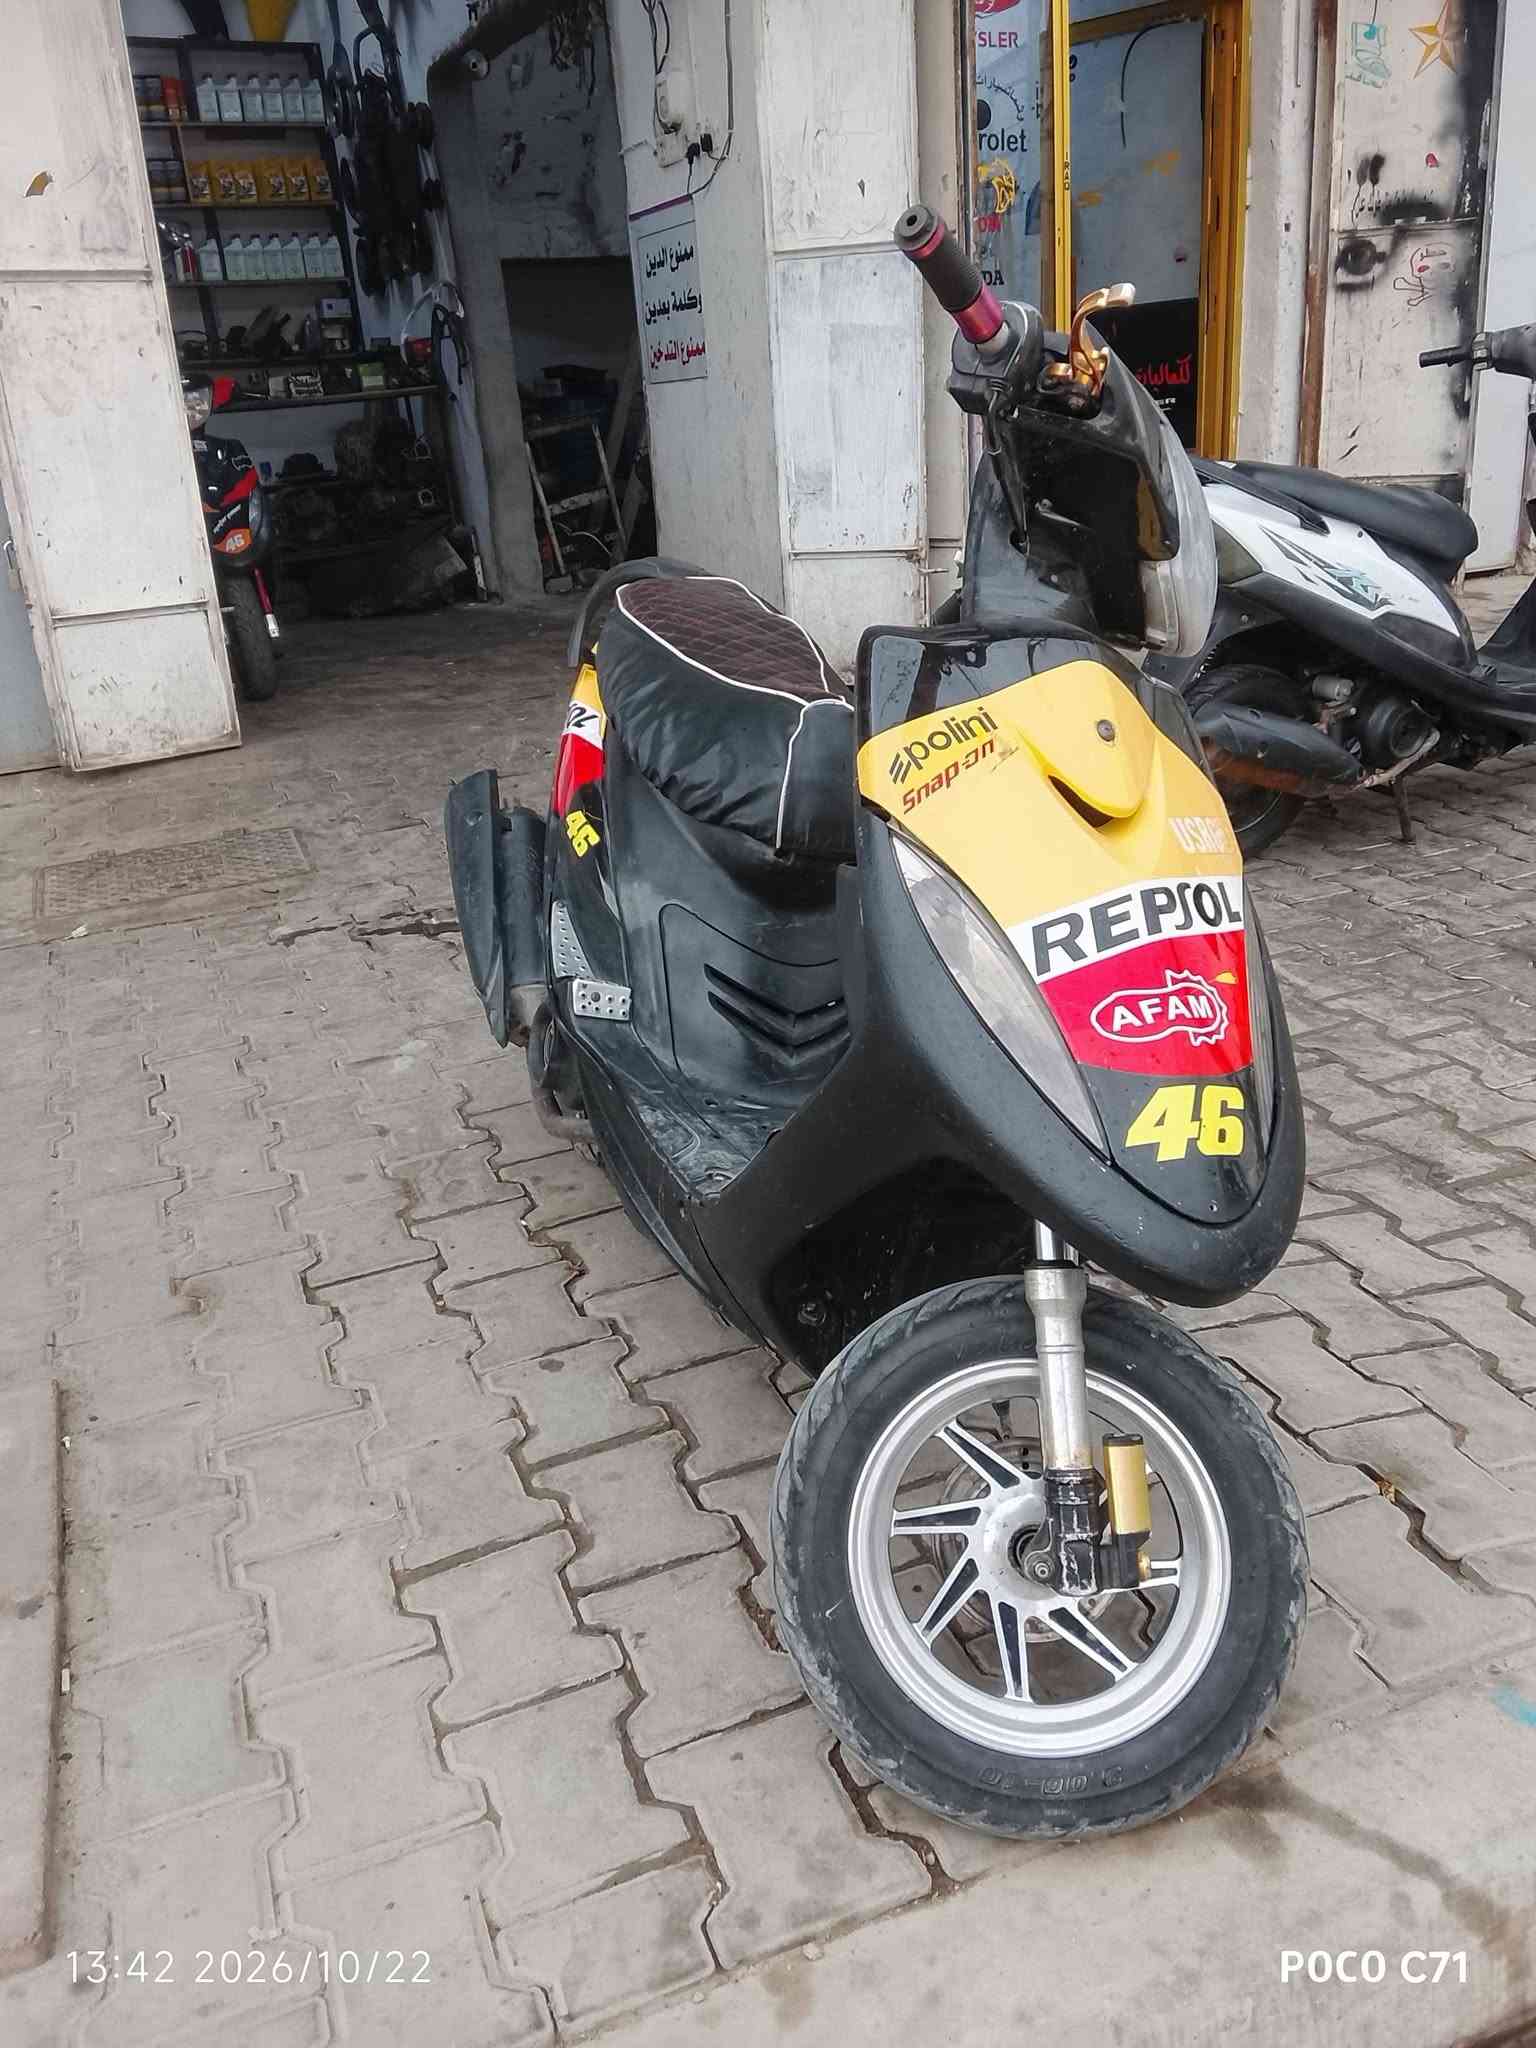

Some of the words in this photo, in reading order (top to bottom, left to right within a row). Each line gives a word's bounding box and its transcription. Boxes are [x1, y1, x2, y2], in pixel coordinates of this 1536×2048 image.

[976, 31, 1019, 48] SLER
[978, 128, 1027, 152] rolet
[669, 240, 694, 273] ممنوع
[680, 337, 706, 366] ممنوع
[903, 706, 998, 770] polini
[565, 809, 600, 858] 46
[1032, 881, 1242, 977] REPSOL
[1112, 994, 1214, 1034] AFAM
[1125, 1084, 1246, 1163] 46
